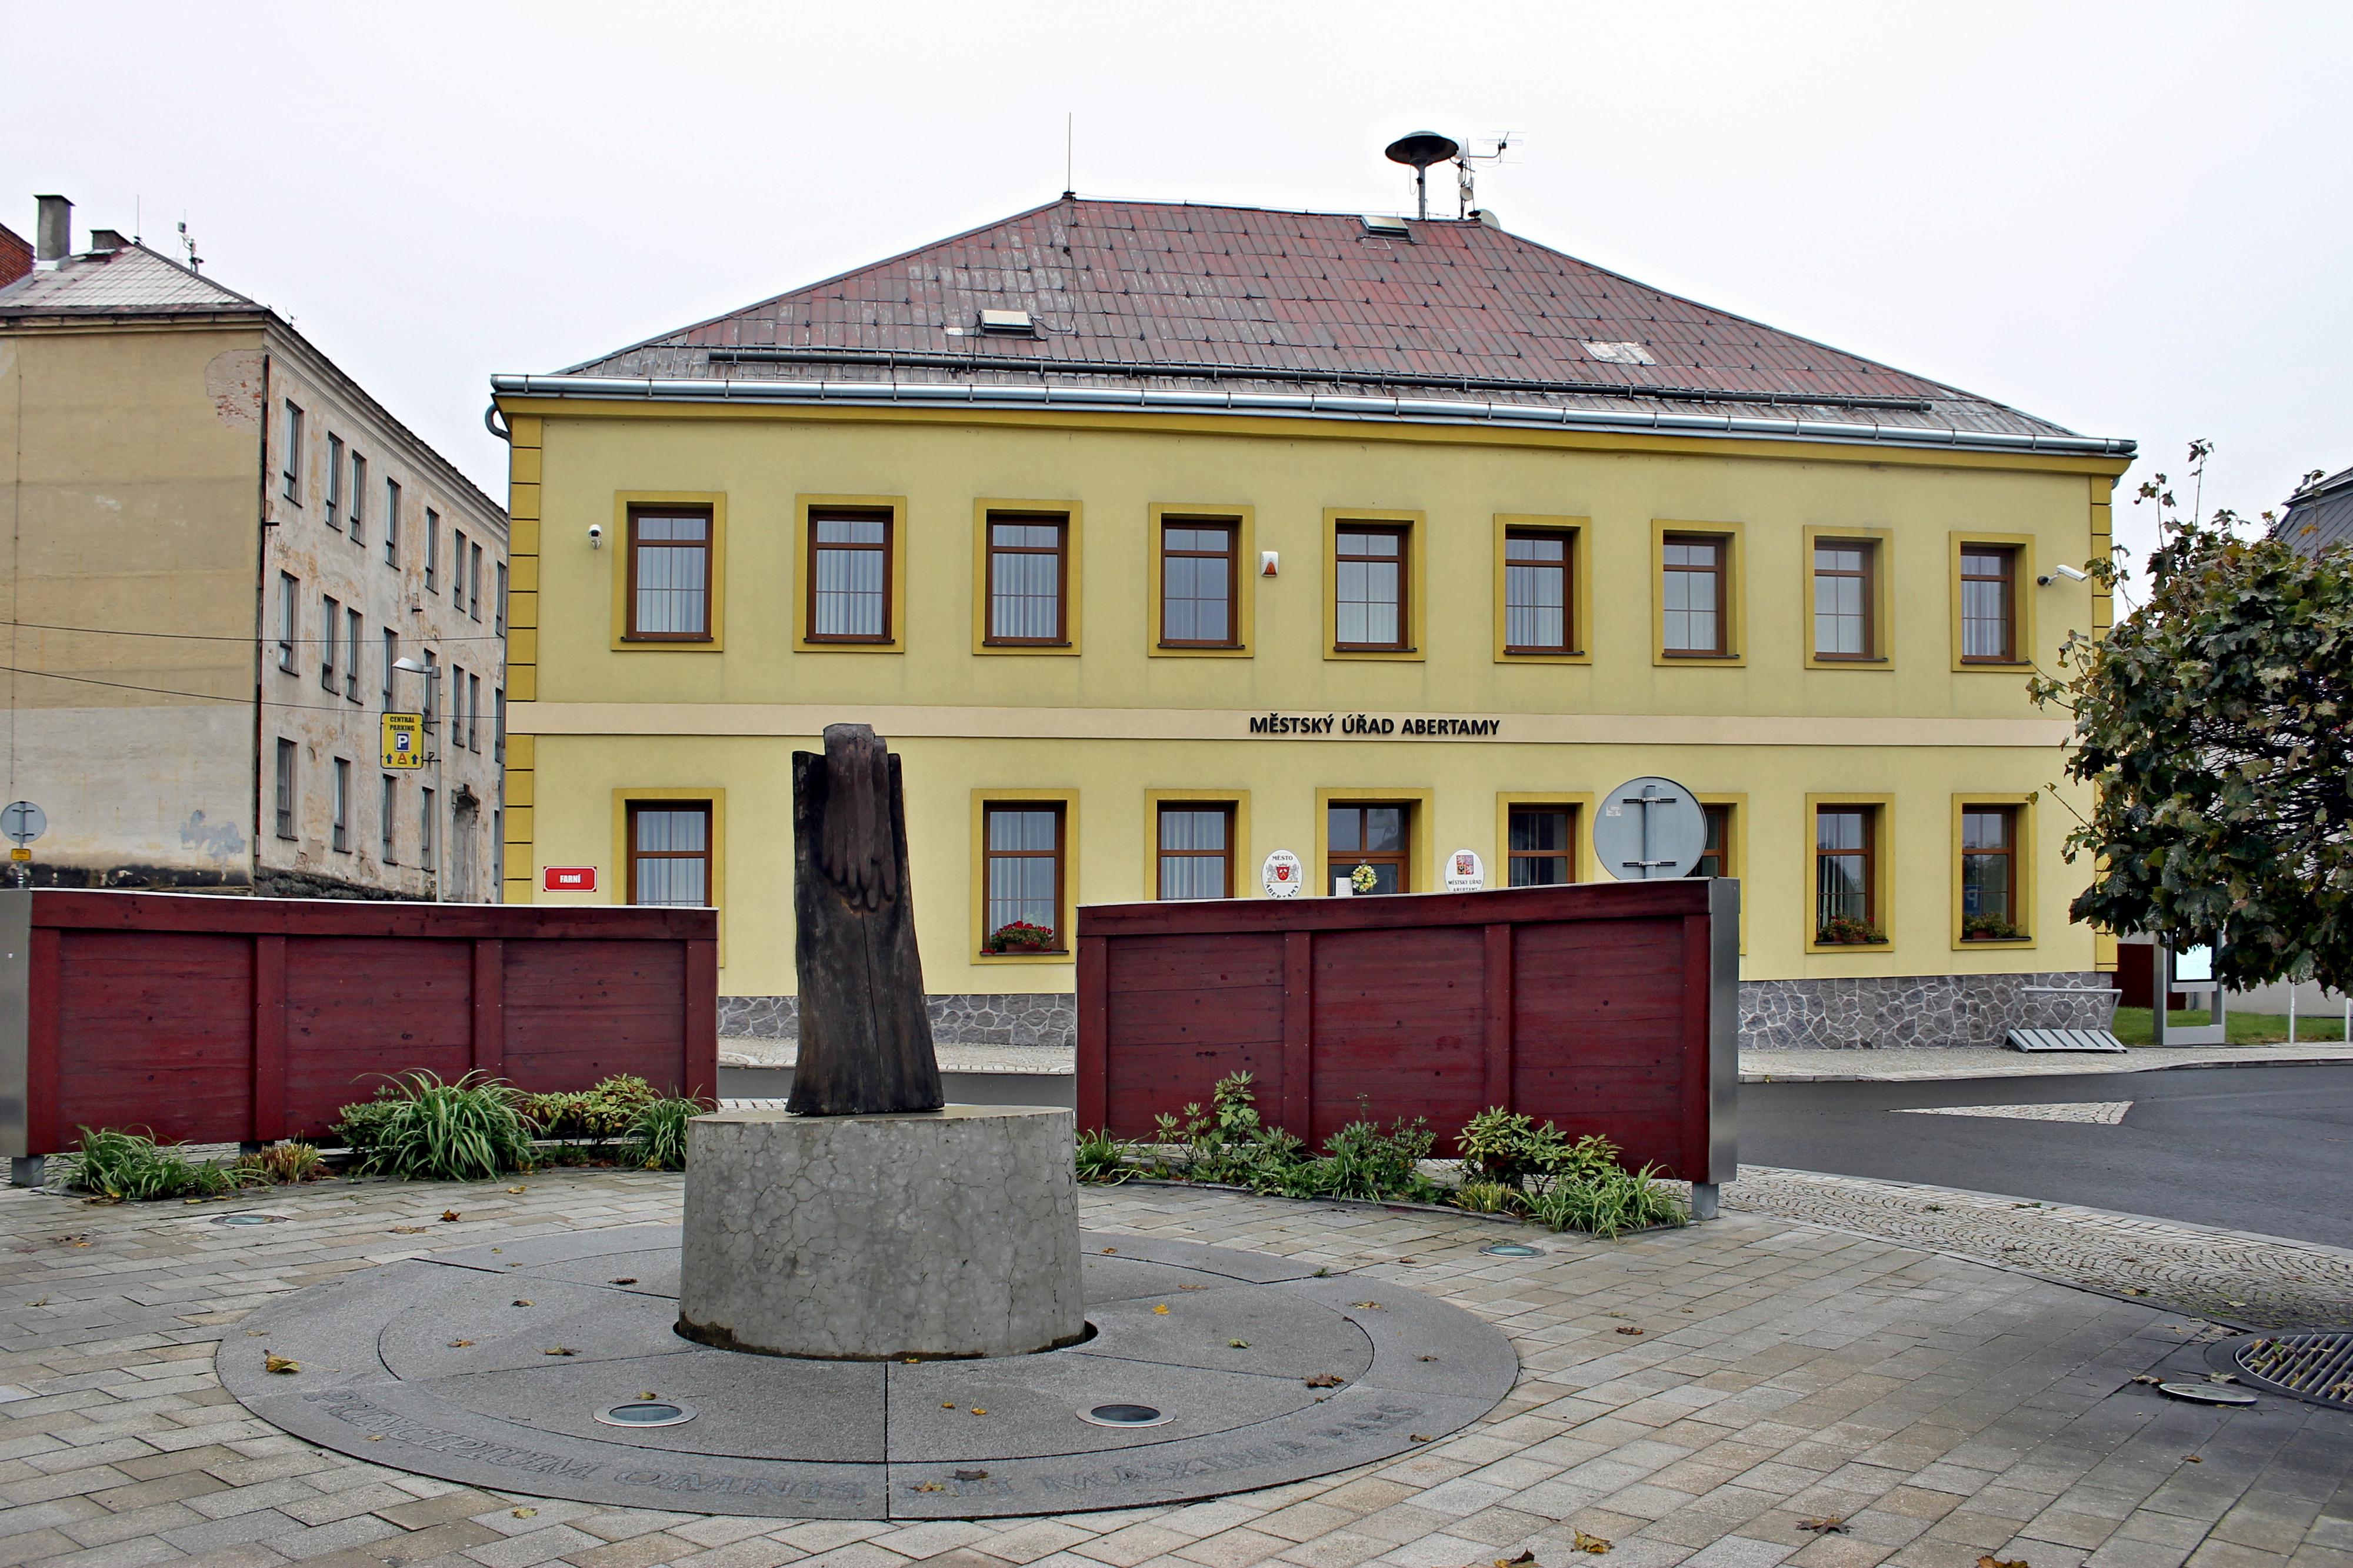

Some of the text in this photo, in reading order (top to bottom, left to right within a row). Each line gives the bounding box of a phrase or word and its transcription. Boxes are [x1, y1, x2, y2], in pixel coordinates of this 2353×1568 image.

[1250, 713, 1500, 735] MĚSTSKÝ ÚŘAD ABERTAMY
[398, 735, 408, 748] P
